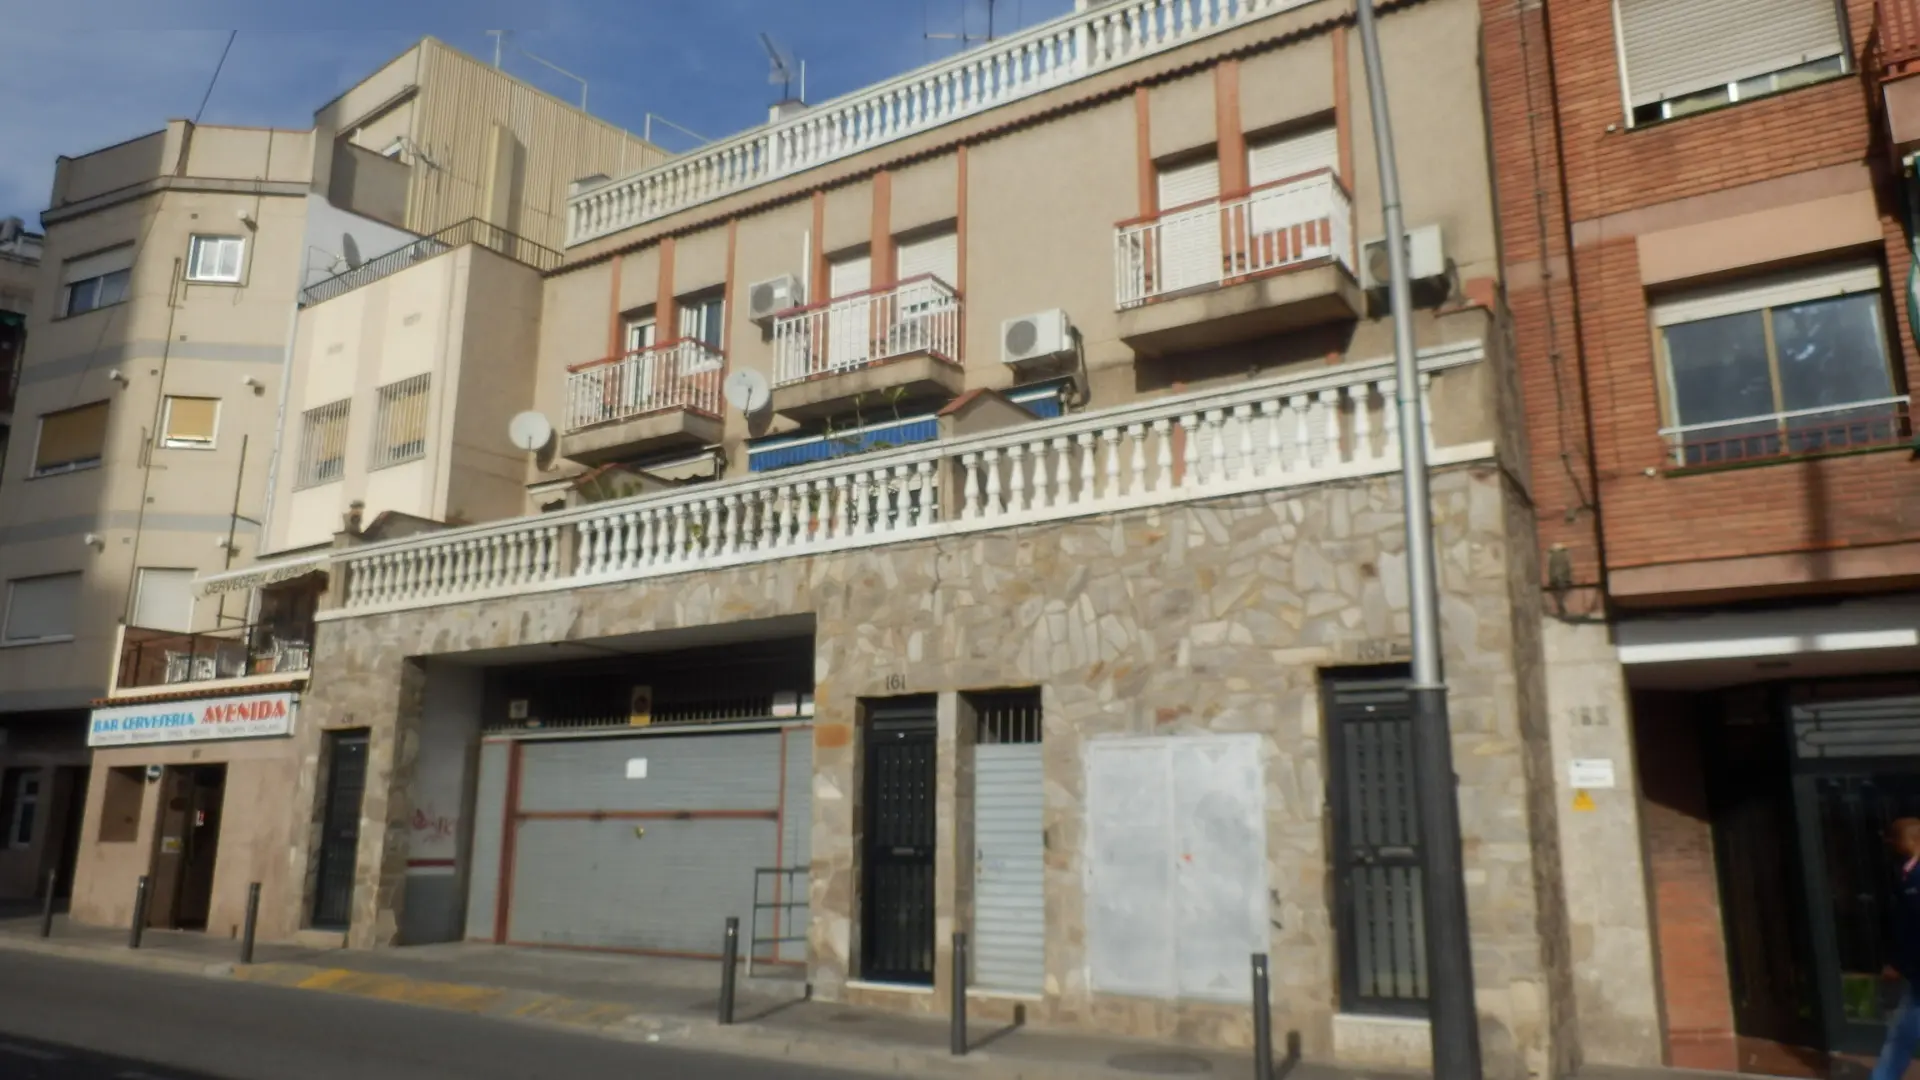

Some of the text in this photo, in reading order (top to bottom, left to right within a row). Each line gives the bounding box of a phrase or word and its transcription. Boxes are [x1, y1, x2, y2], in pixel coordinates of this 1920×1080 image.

[886, 673, 906, 690] 161
[93, 717, 118, 733] BAR
[200, 699, 287, 725] AVENIDA
